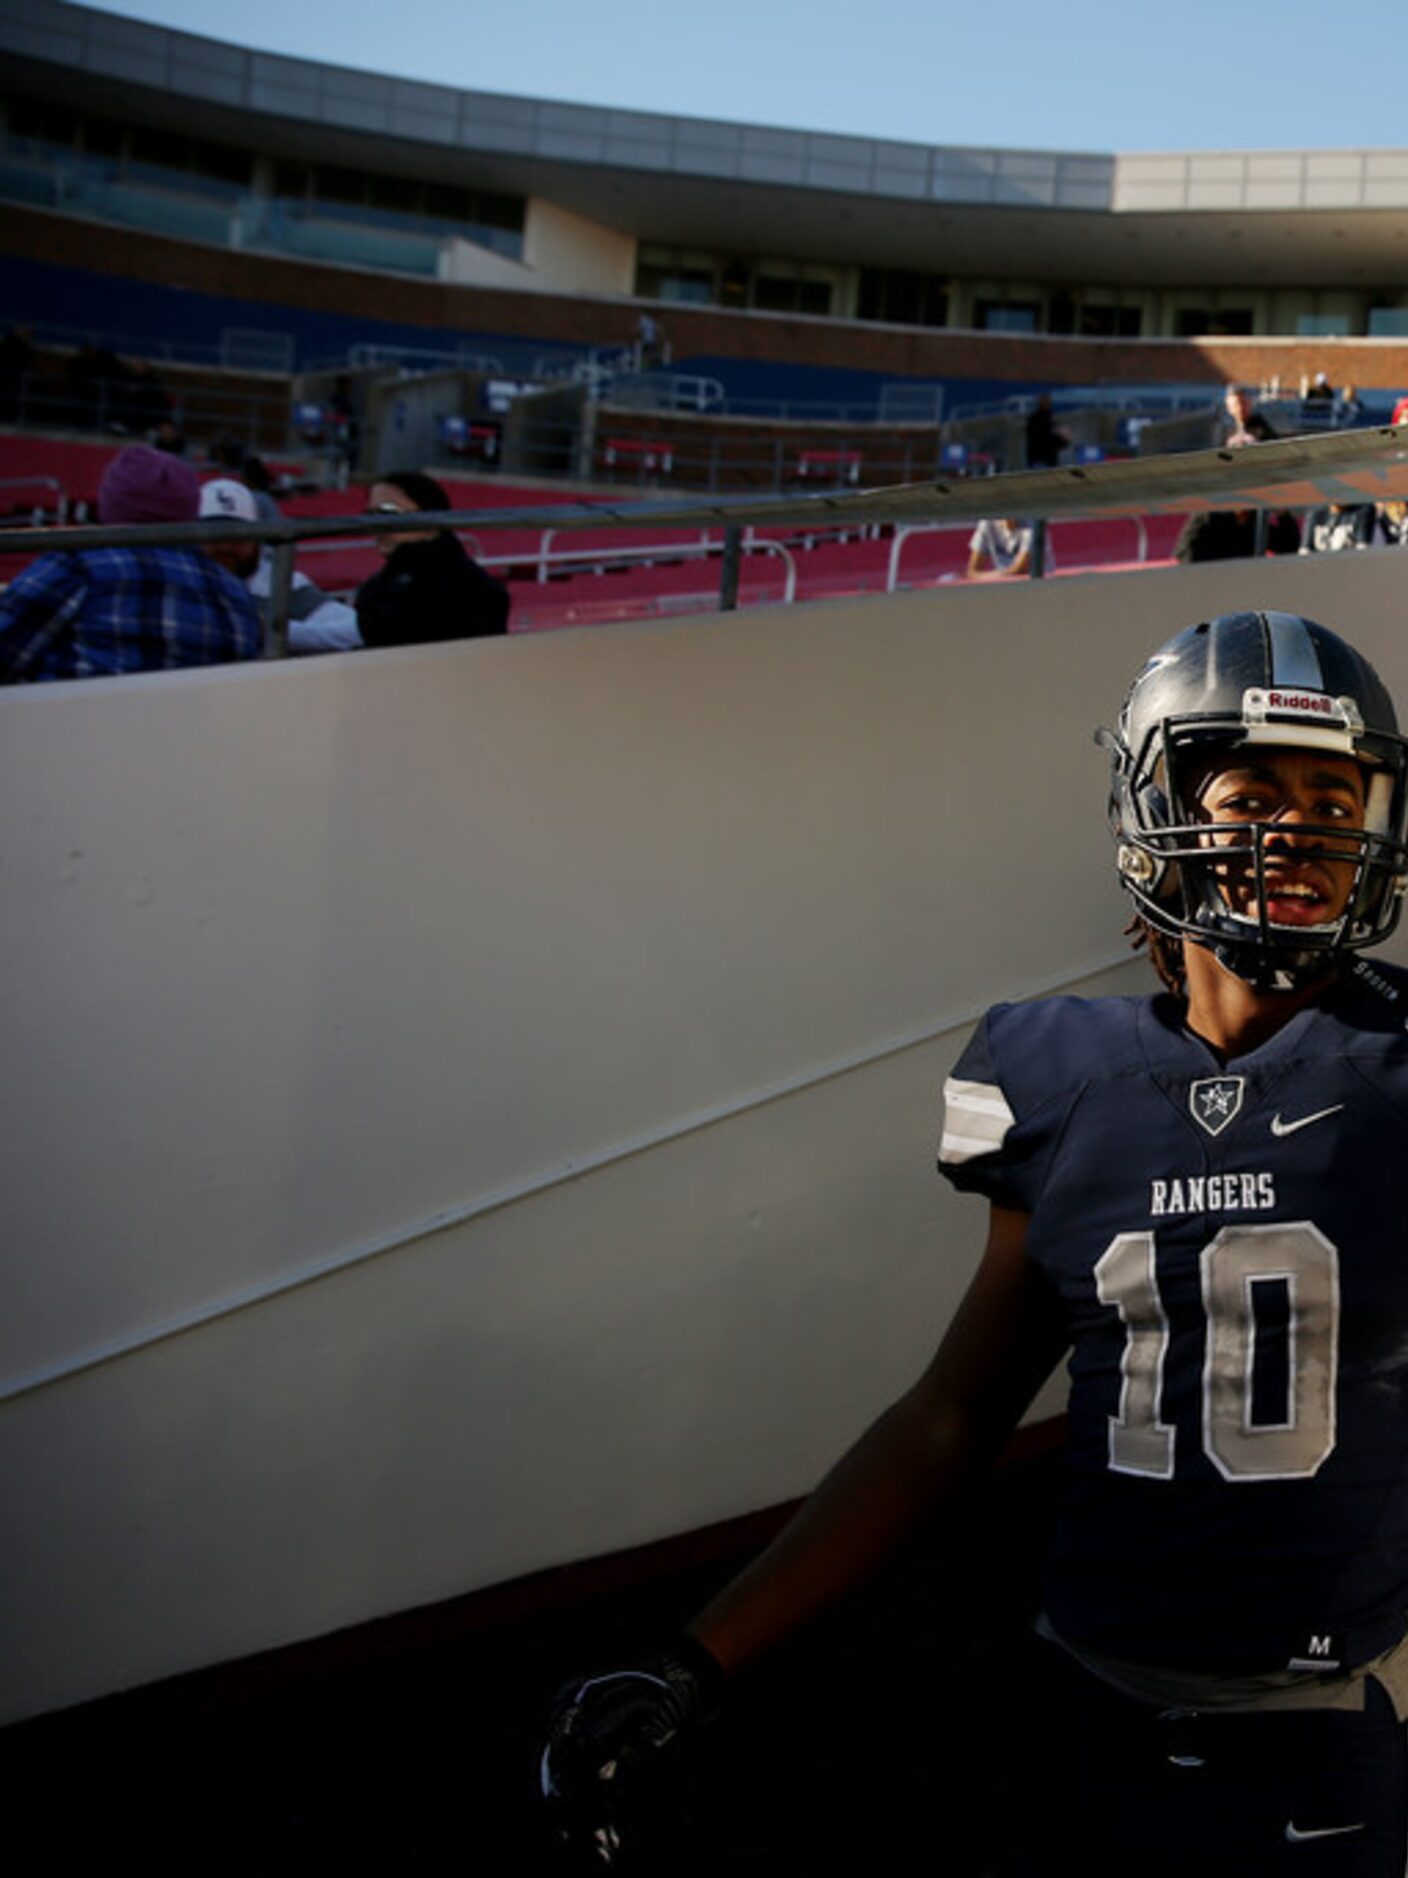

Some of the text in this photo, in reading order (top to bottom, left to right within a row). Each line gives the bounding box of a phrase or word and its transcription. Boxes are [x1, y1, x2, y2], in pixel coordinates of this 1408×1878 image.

[1268, 692, 1332, 714] Riddell
[1150, 1173, 1276, 1215] RANGERS
[1093, 1220, 1340, 1482] 10
[1308, 1635, 1331, 1655] M
